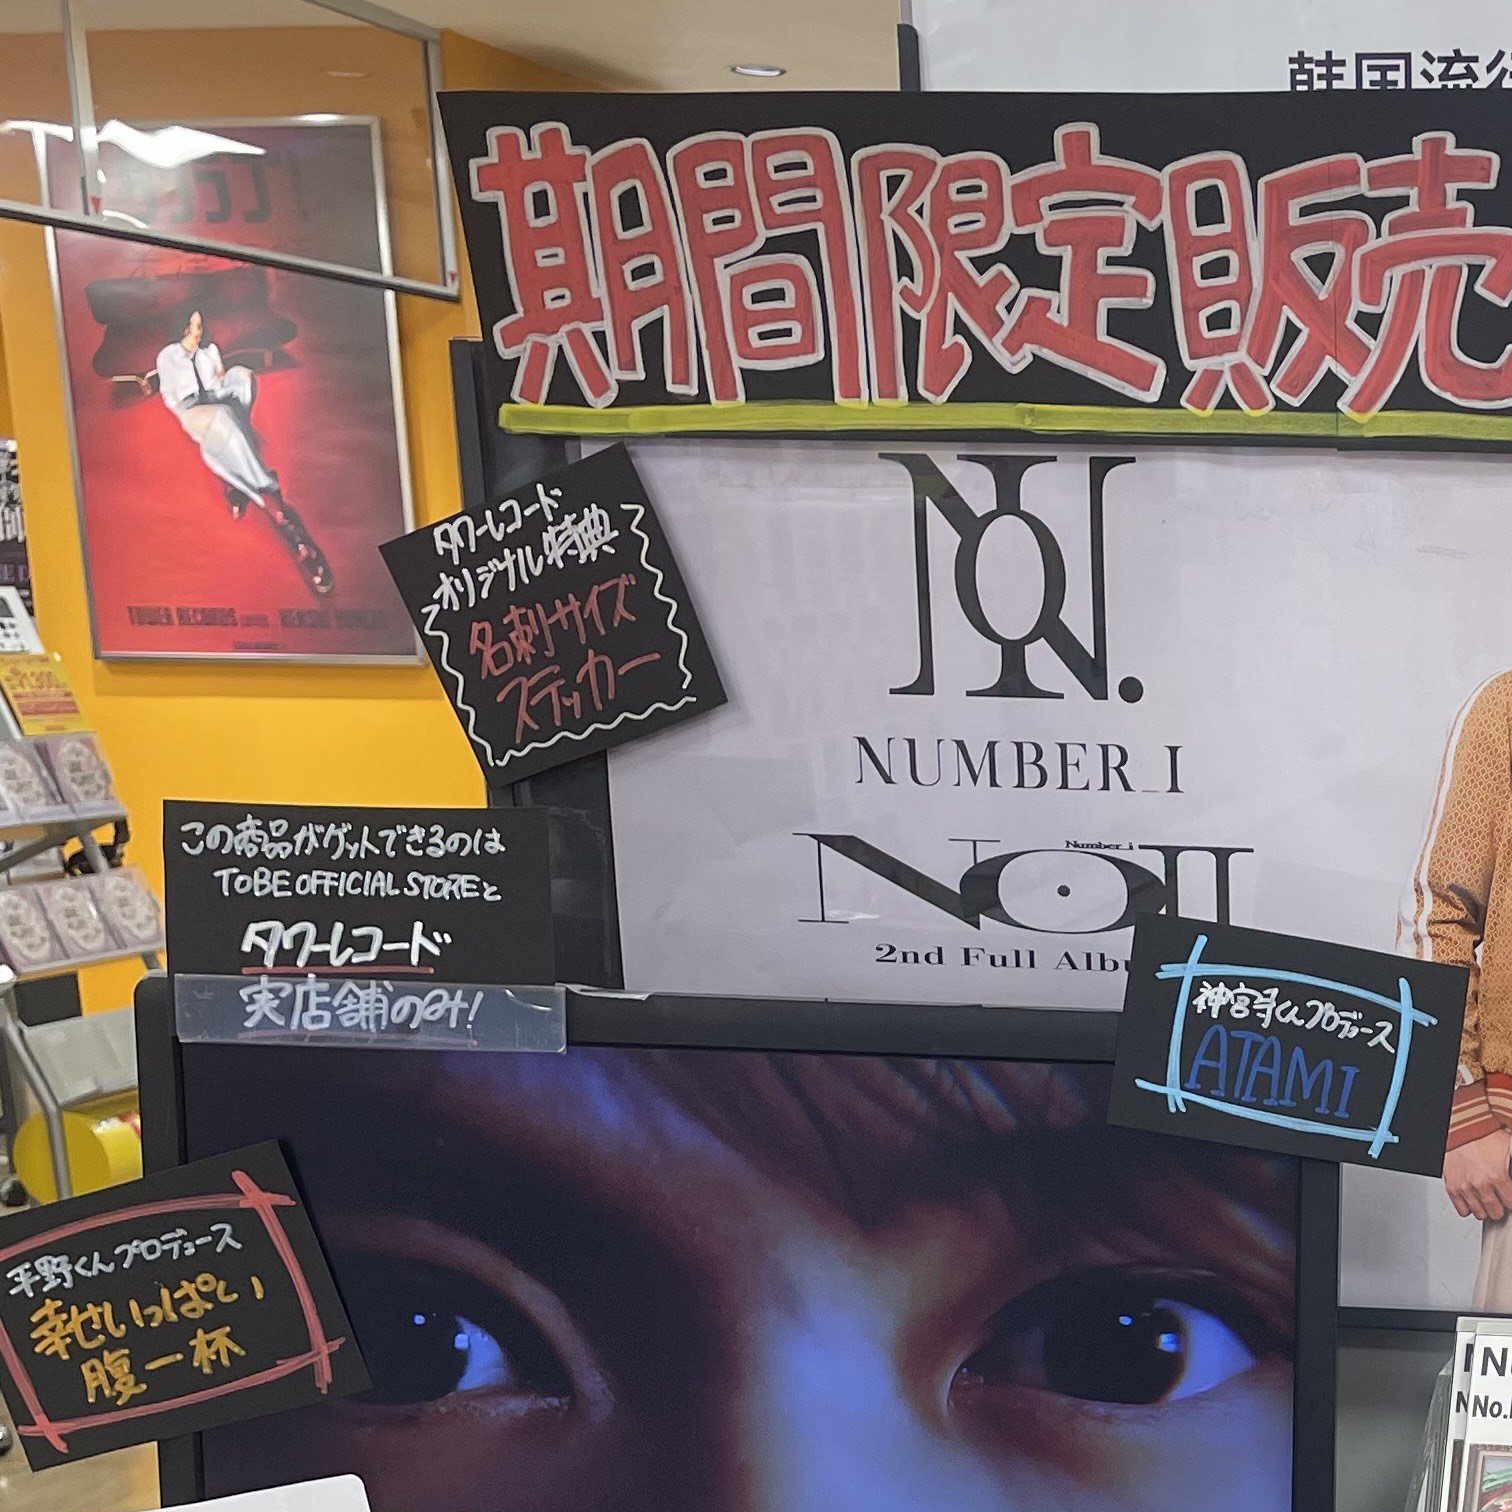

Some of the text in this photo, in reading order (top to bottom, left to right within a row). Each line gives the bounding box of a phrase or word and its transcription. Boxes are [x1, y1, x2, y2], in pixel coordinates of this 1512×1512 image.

[432, 503, 619, 611] オリジナル特典
[433, 484, 562, 564] タワーレコード
[469, 574, 636, 679] 名刺サイズ
[496, 649, 661, 743] ステッカー
[854, 736, 1184, 794] NUMBER_I
[180, 813, 506, 860] この商品がゲットできるのは
[296, 870, 400, 898] OFFICIAL
[240, 920, 453, 969] タワーレコード
[875, 942, 1036, 970] 2nd Full
[239, 973, 485, 1031] 実店舗のみ!
[1184, 1024, 1361, 1118] ATAMI
[6, 1222, 243, 1298] 平野くんプロデュース
[30, 1272, 265, 1360] 幸せいっぱい
[81, 1326, 246, 1406] 腹一杯
